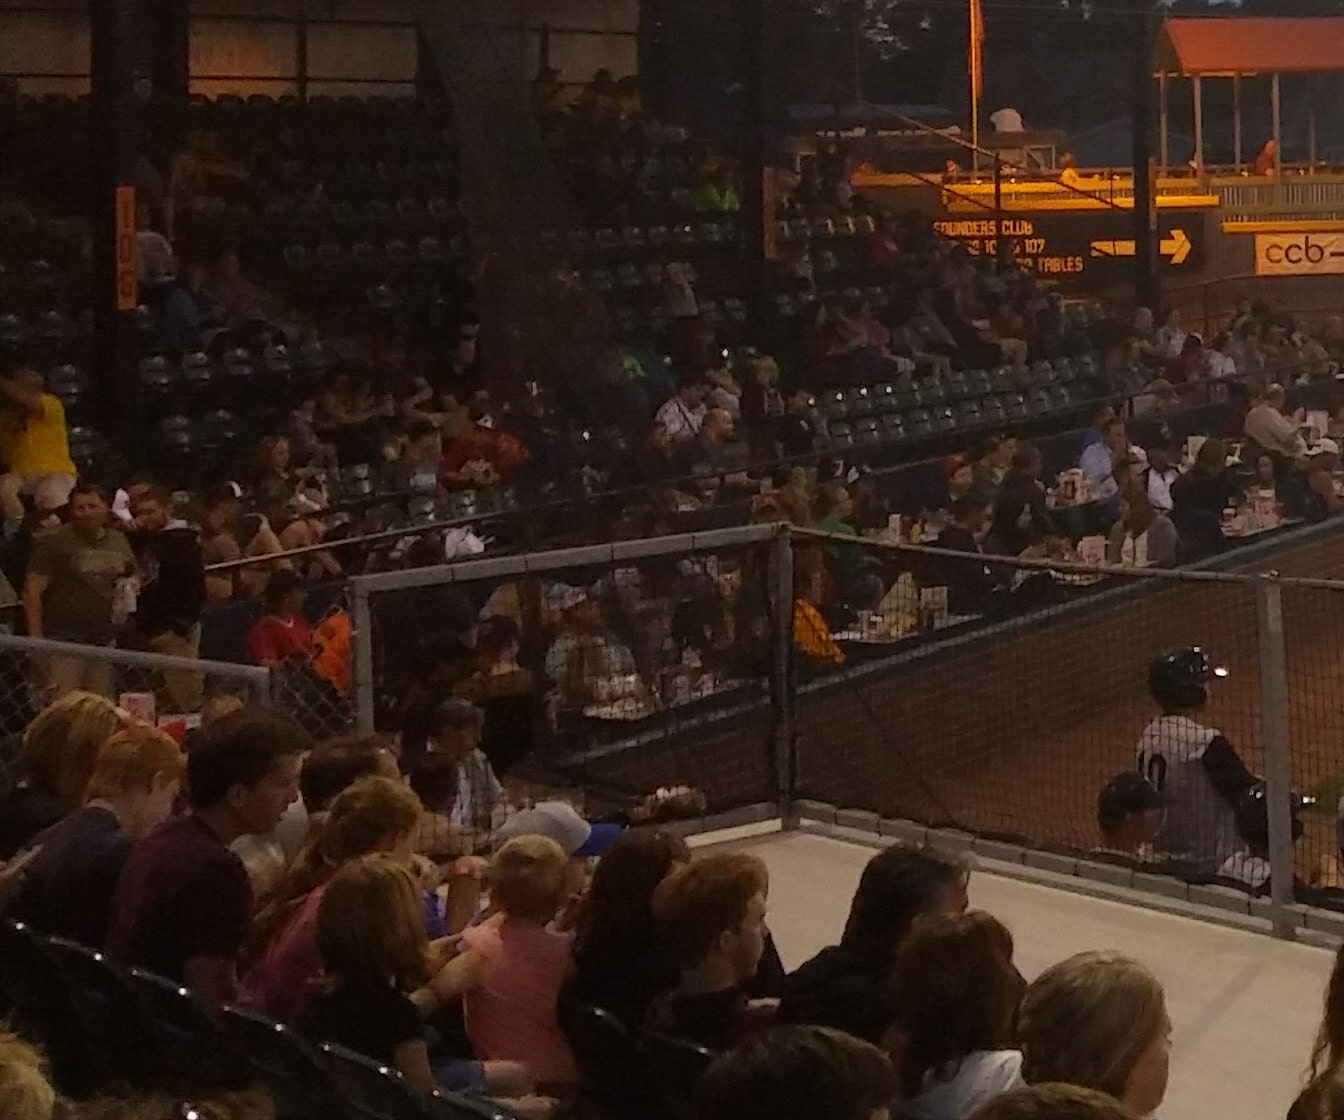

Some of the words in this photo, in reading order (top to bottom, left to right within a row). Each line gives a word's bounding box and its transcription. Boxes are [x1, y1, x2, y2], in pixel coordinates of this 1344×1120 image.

[1002, 220, 1034, 236] CLUB
[1265, 235, 1325, 264] ccb
[1037, 256, 1084, 273] TABLES
